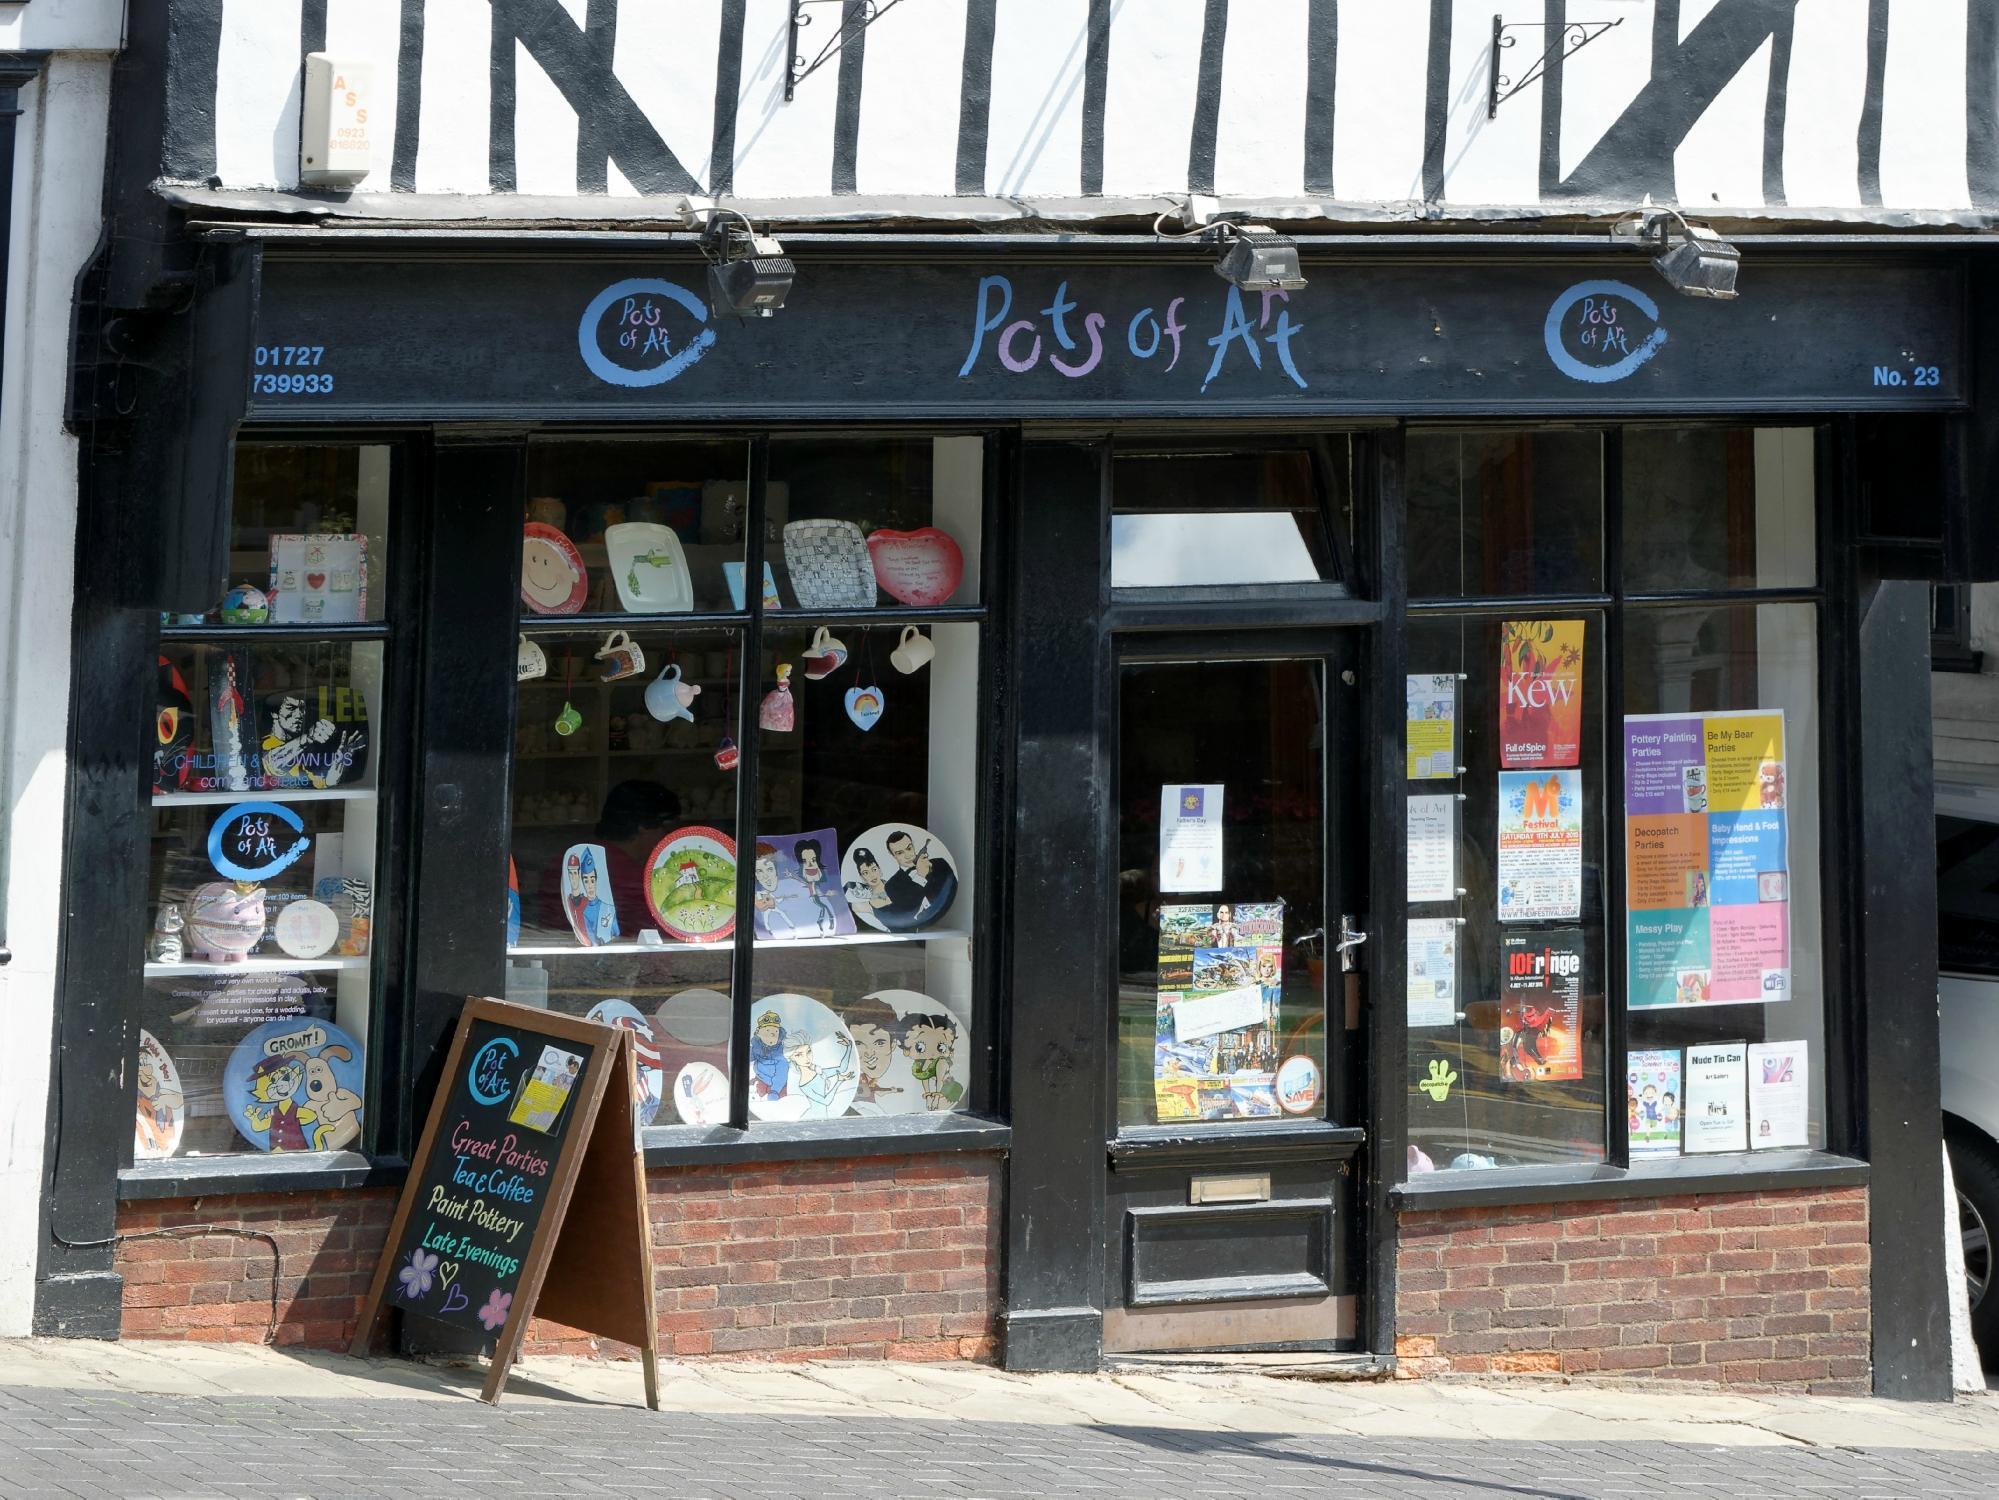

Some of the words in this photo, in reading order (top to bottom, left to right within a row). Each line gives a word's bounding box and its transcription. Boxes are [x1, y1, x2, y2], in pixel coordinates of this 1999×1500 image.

[334, 75, 346, 90] A
[344, 91, 357, 107] S
[356, 108, 368, 124] S
[619, 297, 661, 326] Pots
[1580, 298, 1618, 325] Pots
[958, 274, 1106, 378] Pots
[1127, 297, 1187, 373] of
[619, 328, 639, 350] of
[640, 327, 673, 358] Art
[1580, 327, 1598, 348] of
[1602, 325, 1630, 355] Art
[255, 346, 325, 366] 01727
[253, 373, 334, 394] 739933
[1873, 366, 1908, 386] No.
[1913, 366, 1940, 386] 23
[1507, 672, 1577, 708] Kew
[318, 686, 369, 722] LEE
[1631, 734, 1662, 745] Pottery
[1663, 732, 1697, 743] Painting
[1707, 731, 1719, 741] Be
[1720, 731, 1732, 741] My
[1734, 730, 1754, 739] Bear
[1505, 743, 1518, 752] Full
[1518, 743, 1526, 752] of
[1525, 743, 1546, 753] Spice
[1632, 747, 1662, 757] Parties
[1708, 744, 1736, 752] Parties
[237, 815, 270, 837] Pots
[1523, 819, 1559, 829] Festival
[1634, 827, 1680, 838] Decopatch
[1711, 824, 1733, 834] Baby
[1733, 822, 1754, 832] Hand
[237, 838, 252, 855] of
[254, 836, 278, 859] Art
[1634, 841, 1665, 849] Parties
[1711, 835, 1760, 847] Impressions
[1635, 924, 1663, 936] Messy
[1664, 923, 1684, 935] Play
[482, 1048, 508, 1071] Pot
[1691, 1055, 1712, 1065] Nude
[1713, 1054, 1725, 1064] Tin
[1726, 1053, 1741, 1063] Can
[484, 1070, 510, 1095] Art
[451, 1120, 498, 1160] Great
[495, 1133, 550, 1177] Parties
[452, 1155, 477, 1188] Tea
[487, 1168, 535, 1204] Coffee
[426, 1184, 469, 1221] Paint
[467, 1199, 525, 1243] Pottery
[421, 1221, 457, 1254] Late
[454, 1236, 520, 1279] Evenings
